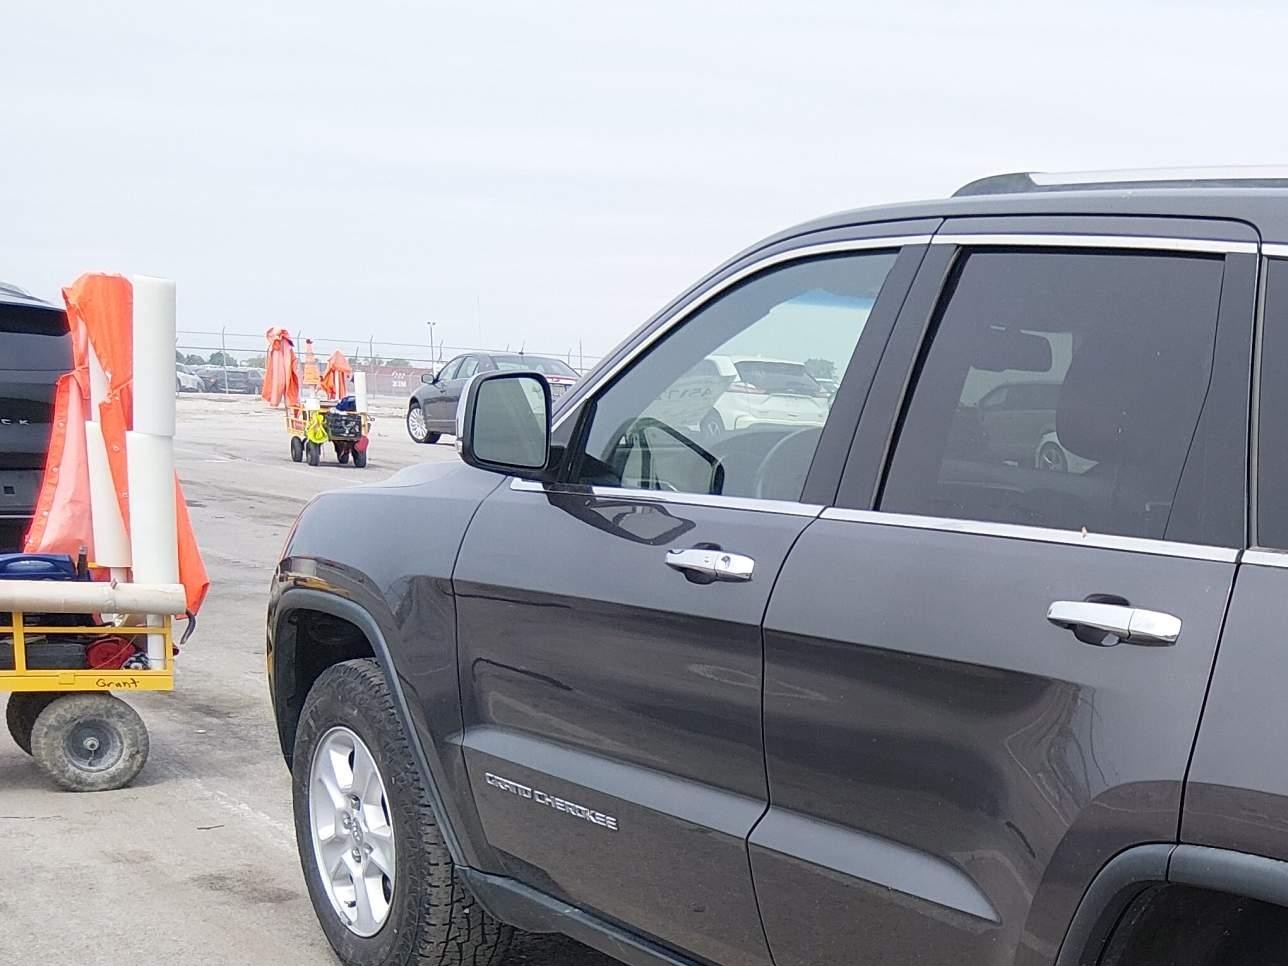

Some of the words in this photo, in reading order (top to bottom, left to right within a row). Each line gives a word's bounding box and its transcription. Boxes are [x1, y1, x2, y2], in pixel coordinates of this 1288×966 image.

[95, 677, 140, 689] Grant
[485, 772, 532, 799] GRAND
[533, 789, 620, 831] CHEROKEE
